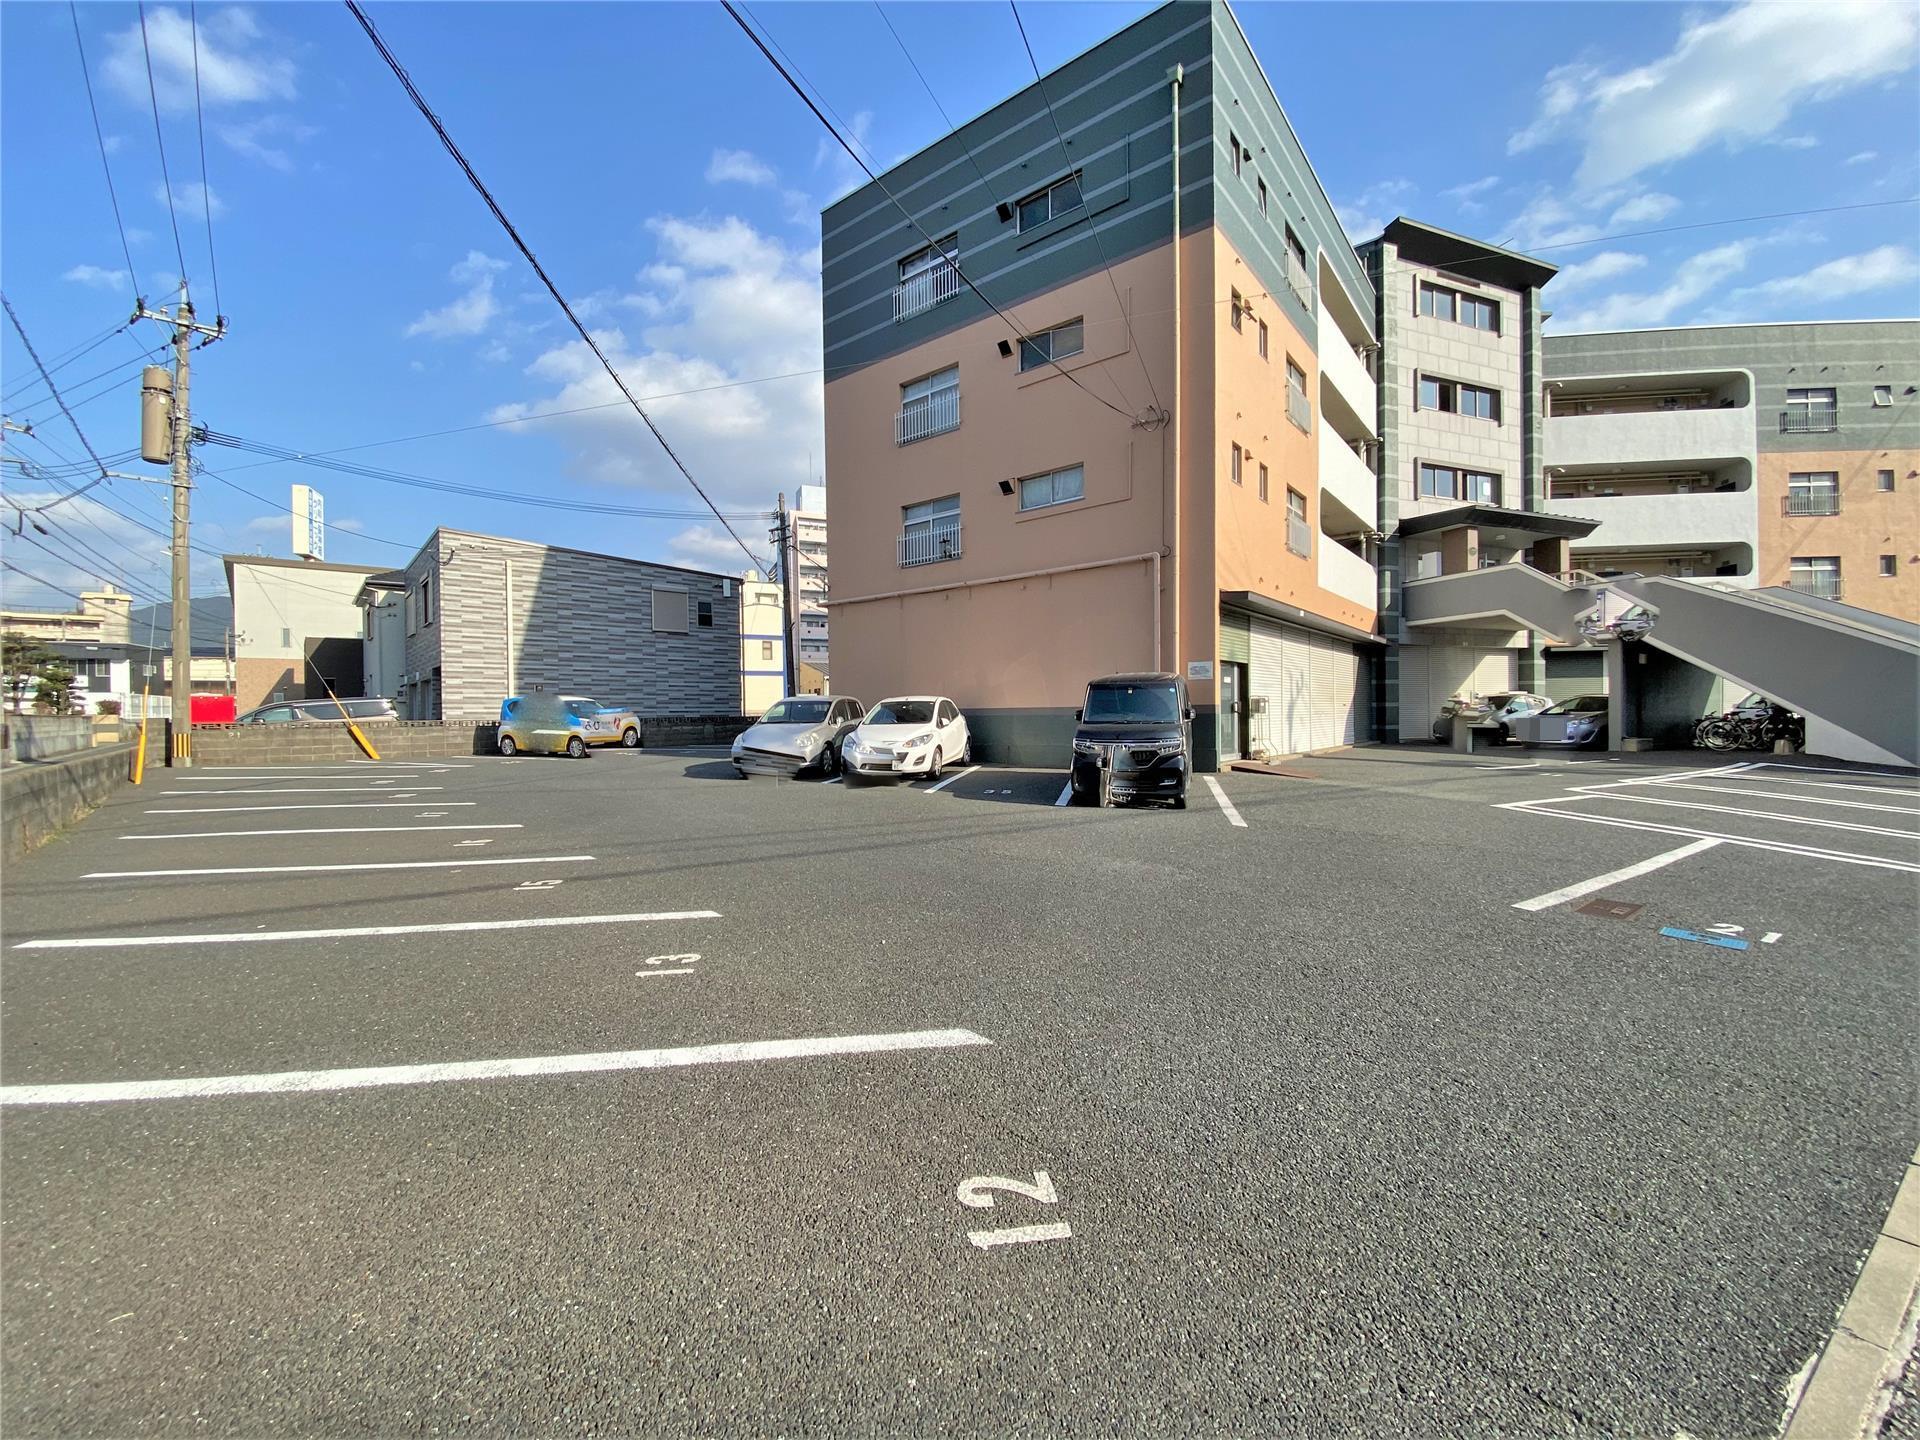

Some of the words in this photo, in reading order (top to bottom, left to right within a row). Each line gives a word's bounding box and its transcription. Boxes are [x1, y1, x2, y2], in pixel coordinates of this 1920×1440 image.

[513, 879, 563, 891] 15
[635, 953, 702, 978] 13
[957, 1171, 1073, 1250] 12
